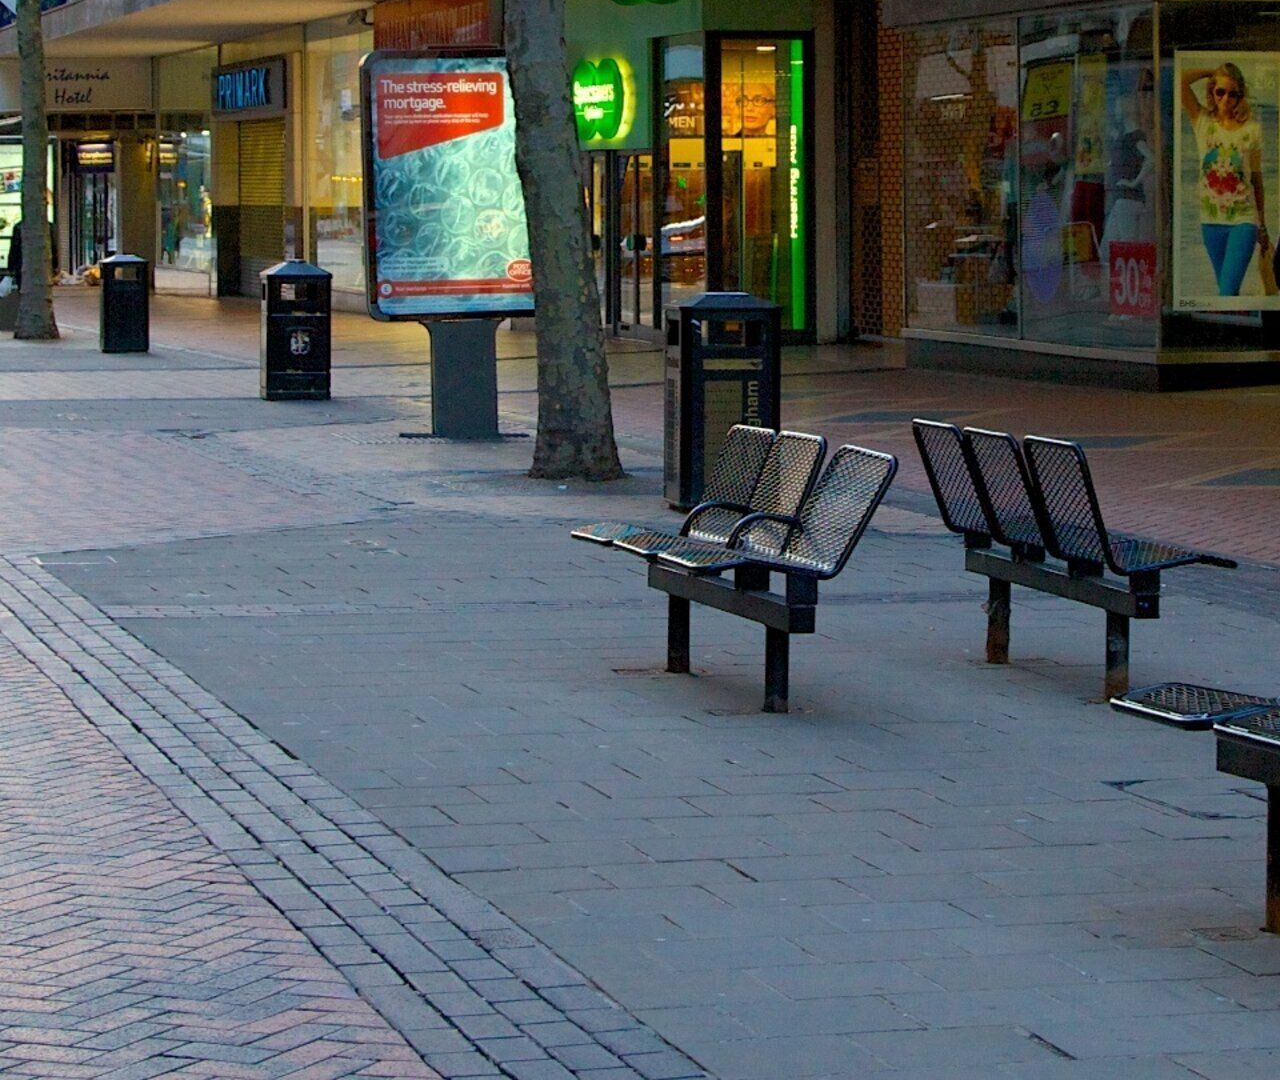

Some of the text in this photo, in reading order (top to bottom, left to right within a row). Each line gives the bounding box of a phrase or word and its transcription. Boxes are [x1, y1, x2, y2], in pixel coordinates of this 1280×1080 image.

[46, 68, 110, 82] ritannia
[218, 67, 267, 110] PRIMARK
[381, 78, 497, 95] The stress-relieving
[54, 88, 93, 104] Hotel
[383, 97, 446, 112] mortgage.
